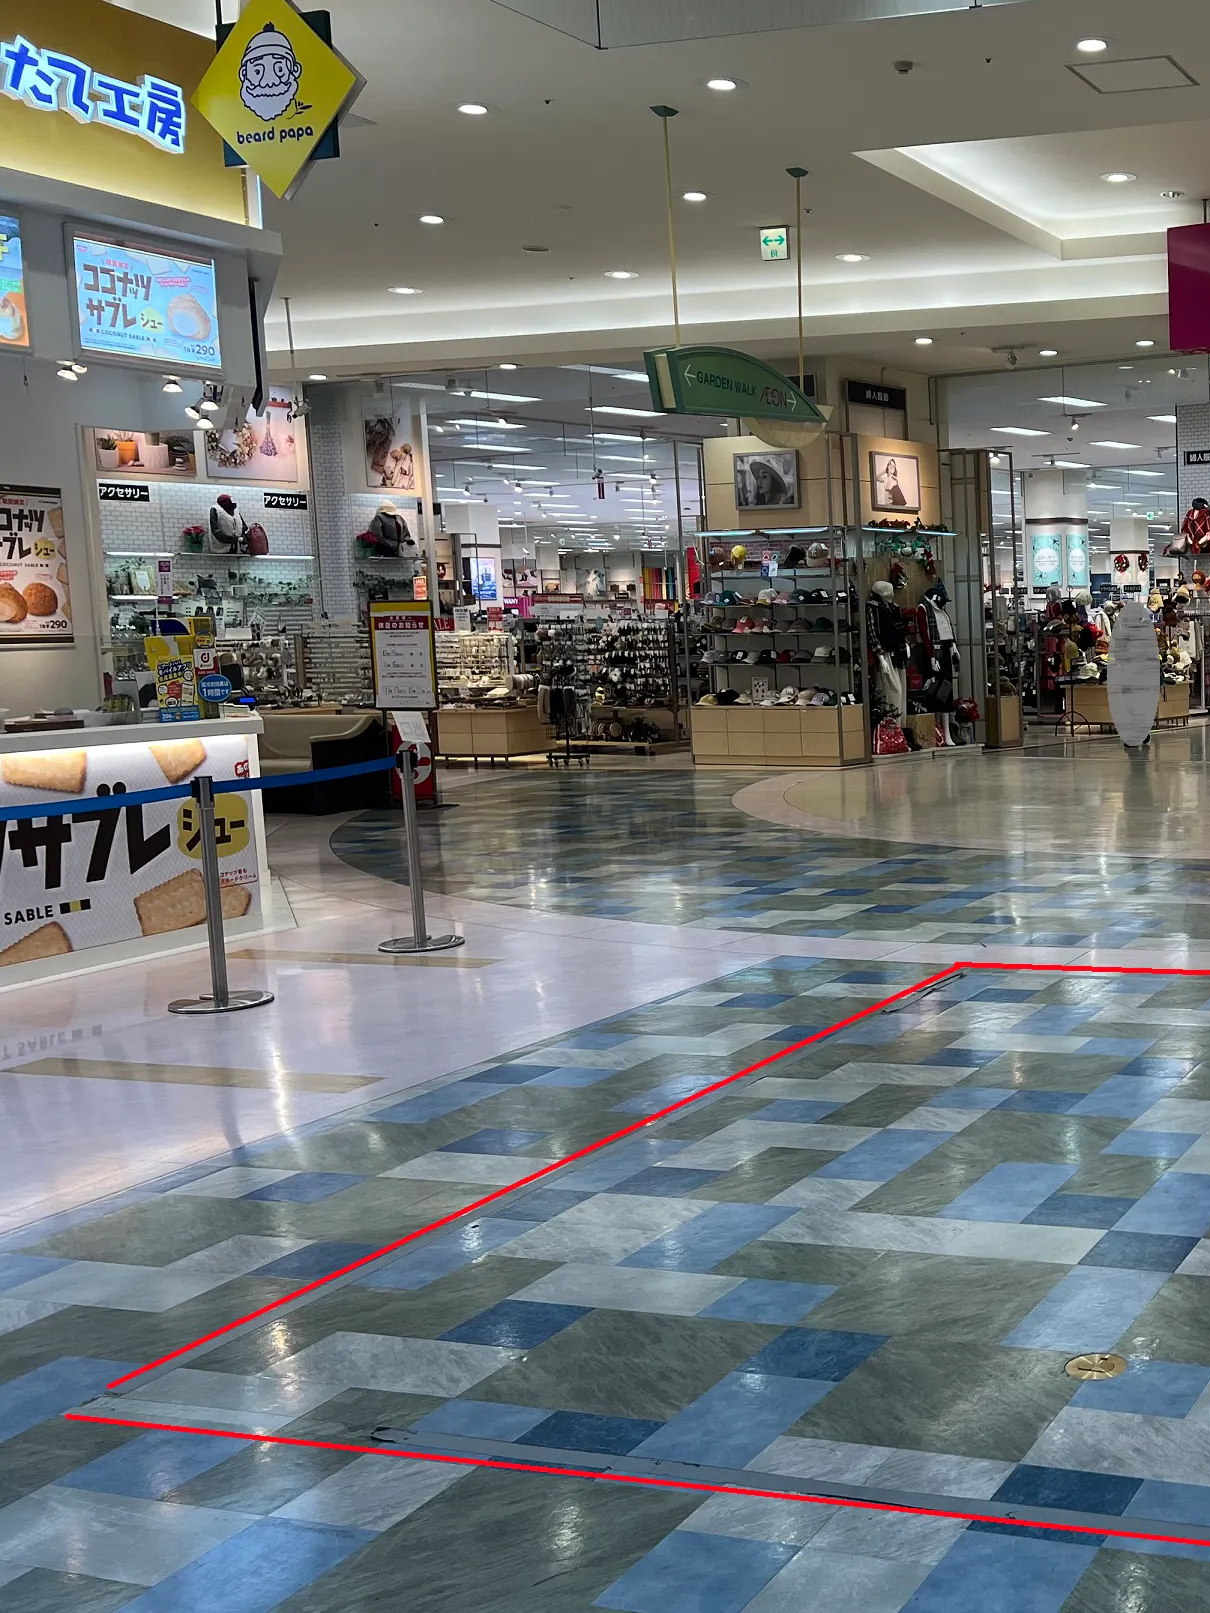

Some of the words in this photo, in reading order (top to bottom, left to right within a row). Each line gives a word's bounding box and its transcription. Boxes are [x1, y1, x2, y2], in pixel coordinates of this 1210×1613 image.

[236, 126, 275, 145] beard
[279, 125, 314, 144] papa
[86, 296, 137, 329] サブレ
[140, 313, 163, 328] シュー
[101, 329, 128, 338] COCONUT
[696, 370, 733, 392] GARDEN
[734, 381, 757, 397] WALK
[98, 485, 149, 499] アクセサリー
[263, 495, 307, 507] アクセサリー
[0, 532, 31, 559] ブレ
[34, 543, 55, 557] シュー
[434, 618, 450, 631] ALE
[8, 782, 171, 889] サブレ
[4, 904, 54, 926] SABLE
